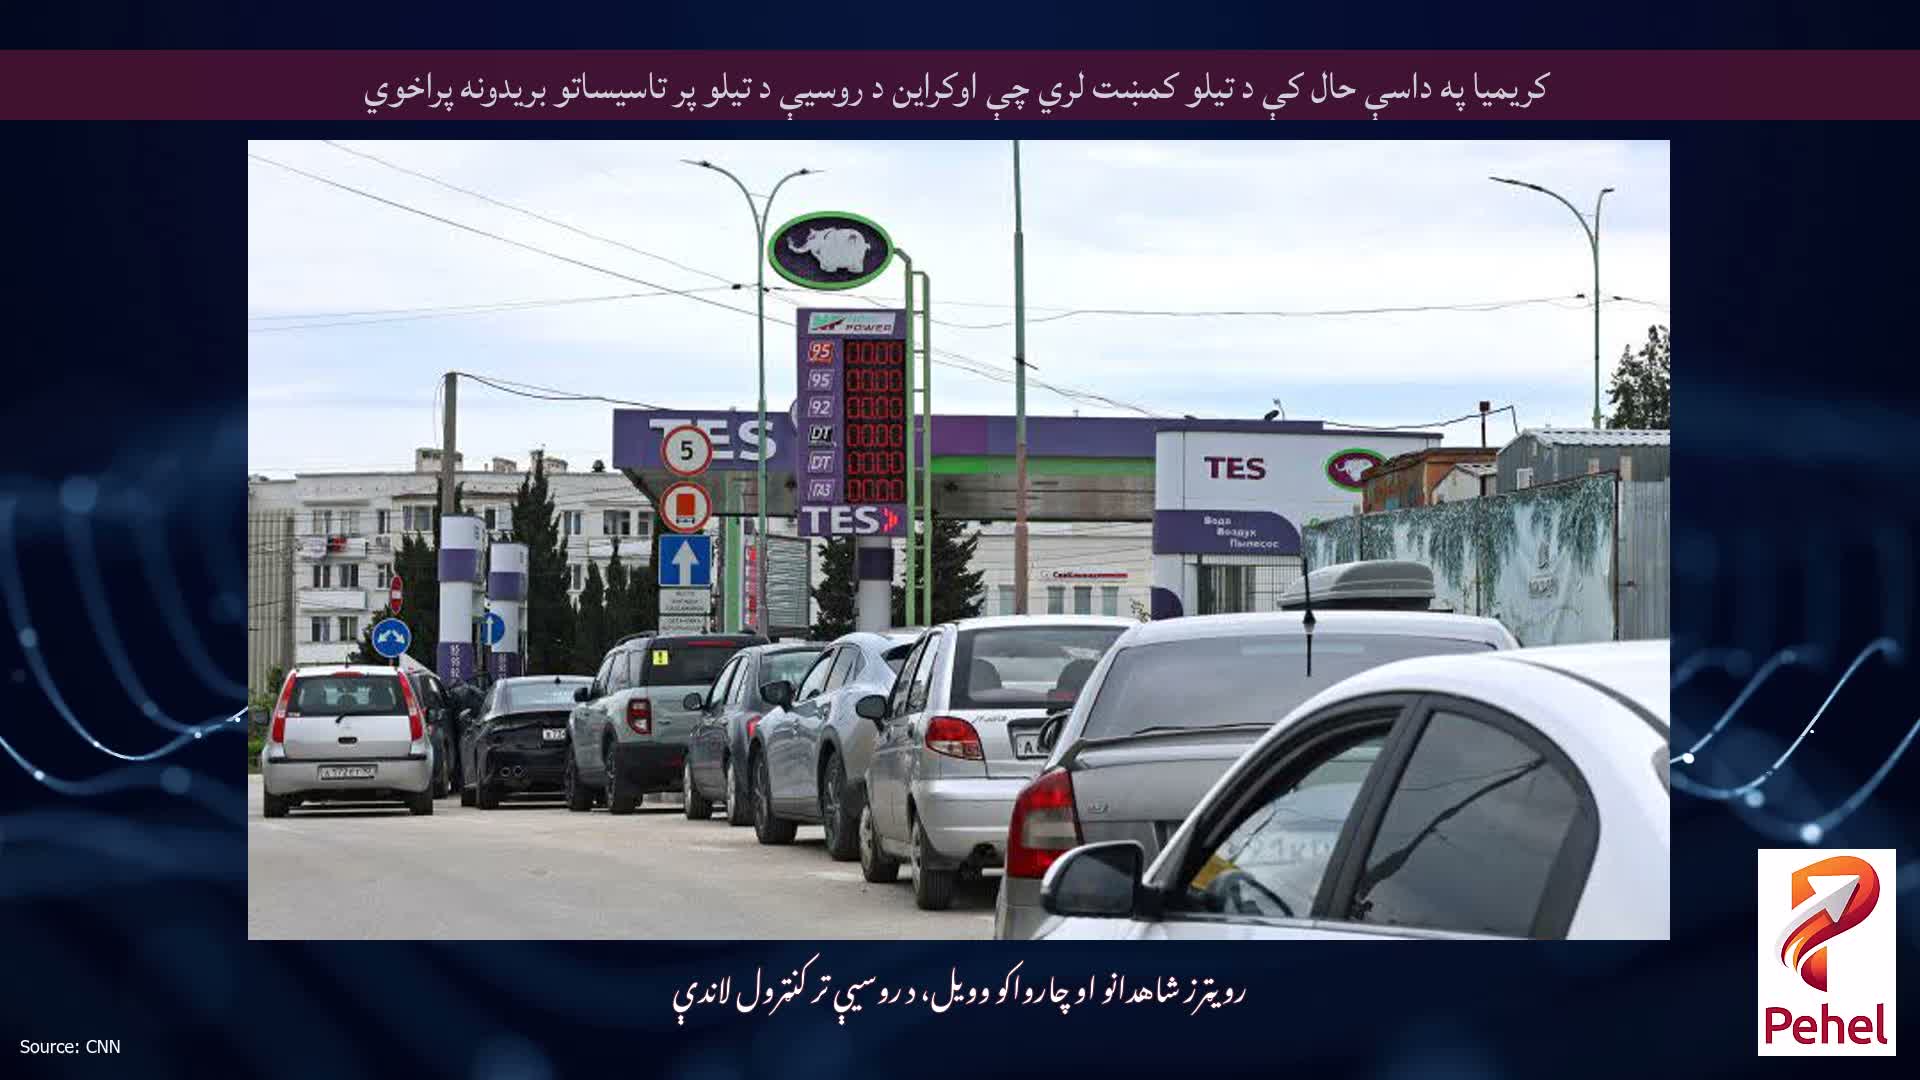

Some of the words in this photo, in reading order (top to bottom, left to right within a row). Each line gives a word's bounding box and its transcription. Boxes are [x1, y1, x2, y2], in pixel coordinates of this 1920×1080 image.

[813, 344, 830, 358] 95
[812, 373, 830, 387] 95
[812, 400, 831, 415] 92
[649, 418, 777, 461] TES
[681, 441, 694, 461] 5
[1204, 456, 1266, 480] TES
[801, 506, 879, 534] TES
